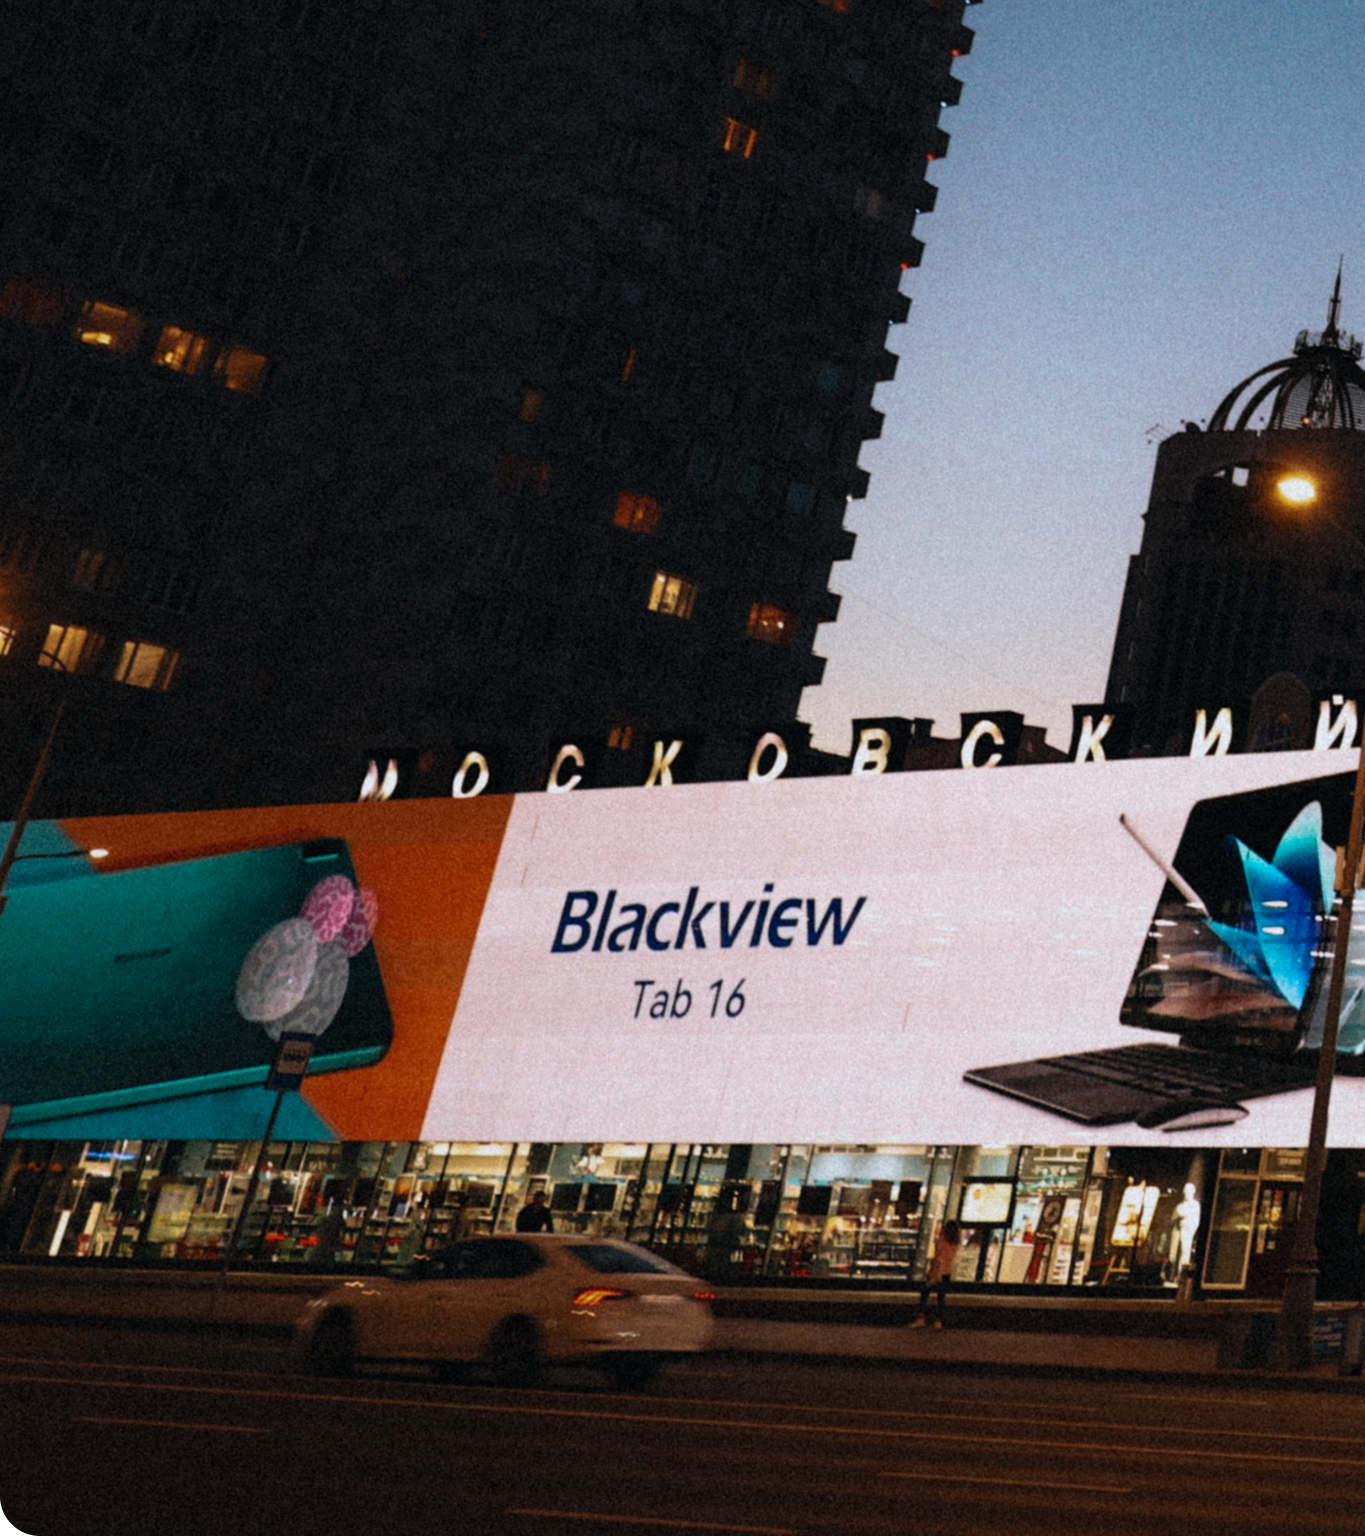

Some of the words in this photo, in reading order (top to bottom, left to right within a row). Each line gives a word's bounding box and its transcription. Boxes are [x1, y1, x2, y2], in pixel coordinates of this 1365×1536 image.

[551, 883, 867, 953] Blackview
[633, 979, 692, 1019] Tab
[709, 978, 747, 1018] 16
